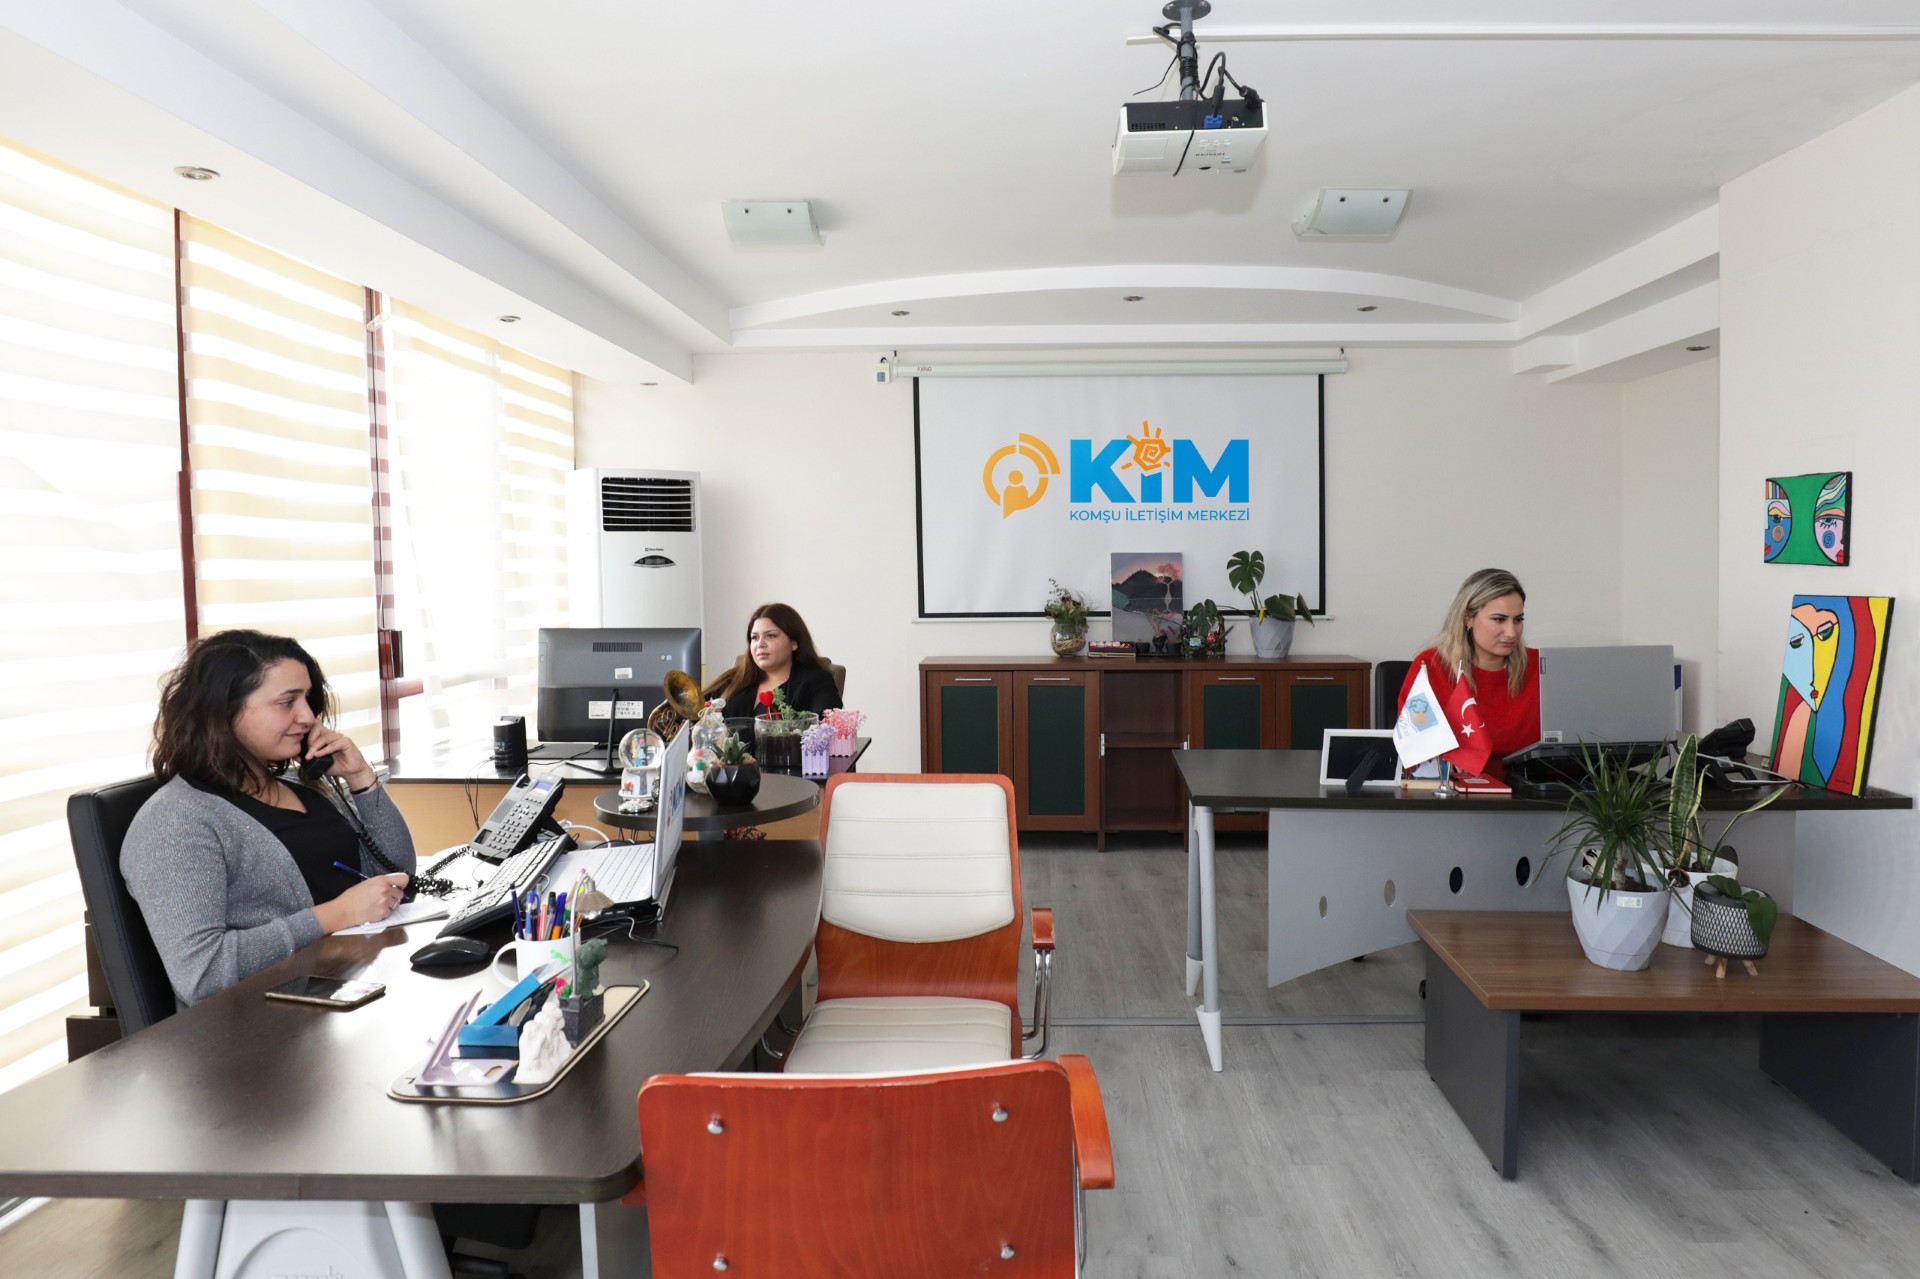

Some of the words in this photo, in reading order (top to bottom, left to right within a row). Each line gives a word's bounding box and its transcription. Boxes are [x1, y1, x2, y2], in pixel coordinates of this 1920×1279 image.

[1069, 509, 1121, 524] KOMŞU
[1125, 508, 1183, 524] İLETİŞİM
[1187, 508, 1250, 521] MERKEZİ
